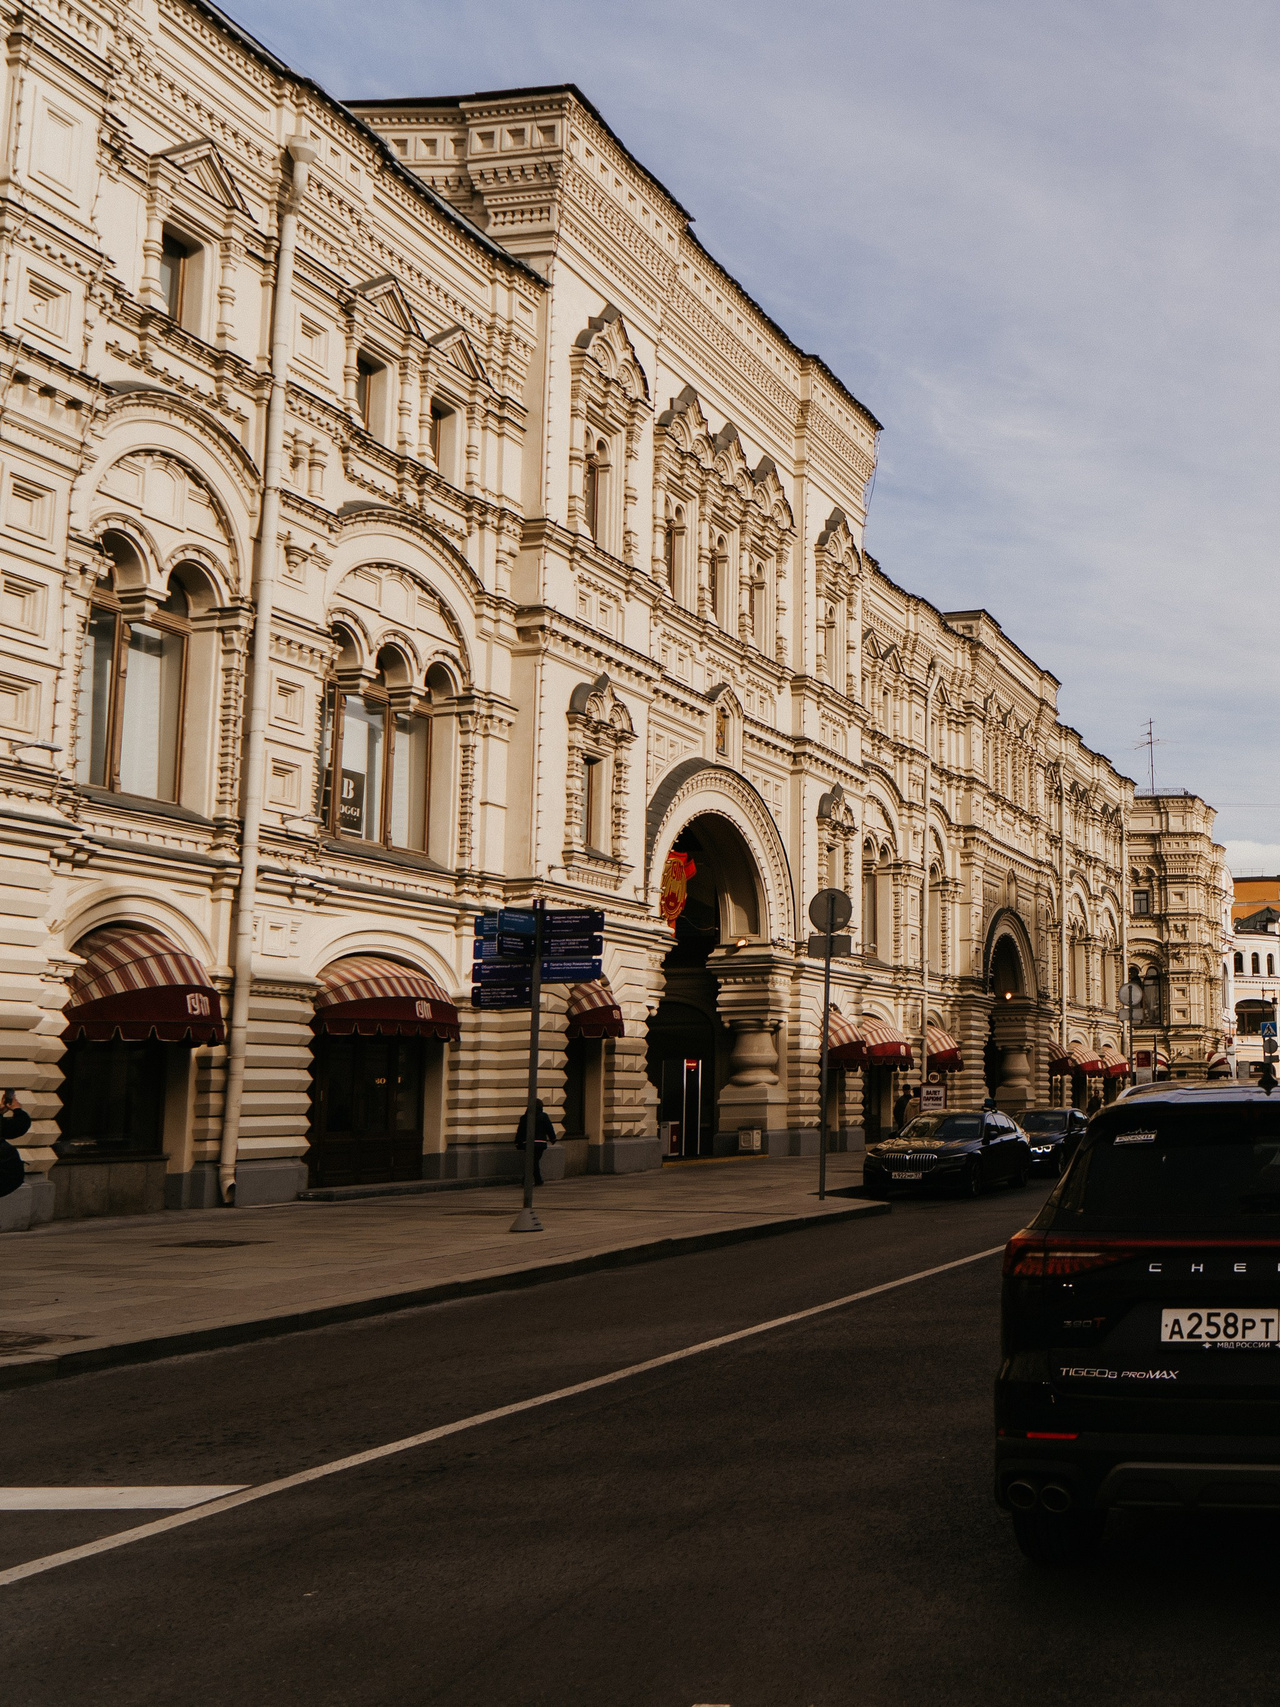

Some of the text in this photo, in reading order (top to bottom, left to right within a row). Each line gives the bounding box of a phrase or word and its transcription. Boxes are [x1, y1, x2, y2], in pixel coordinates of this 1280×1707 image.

[341, 777, 355, 799] B
[340, 804, 361, 817] OGGI
[1216, 1341, 1271, 1349] МВД РОССИИ
